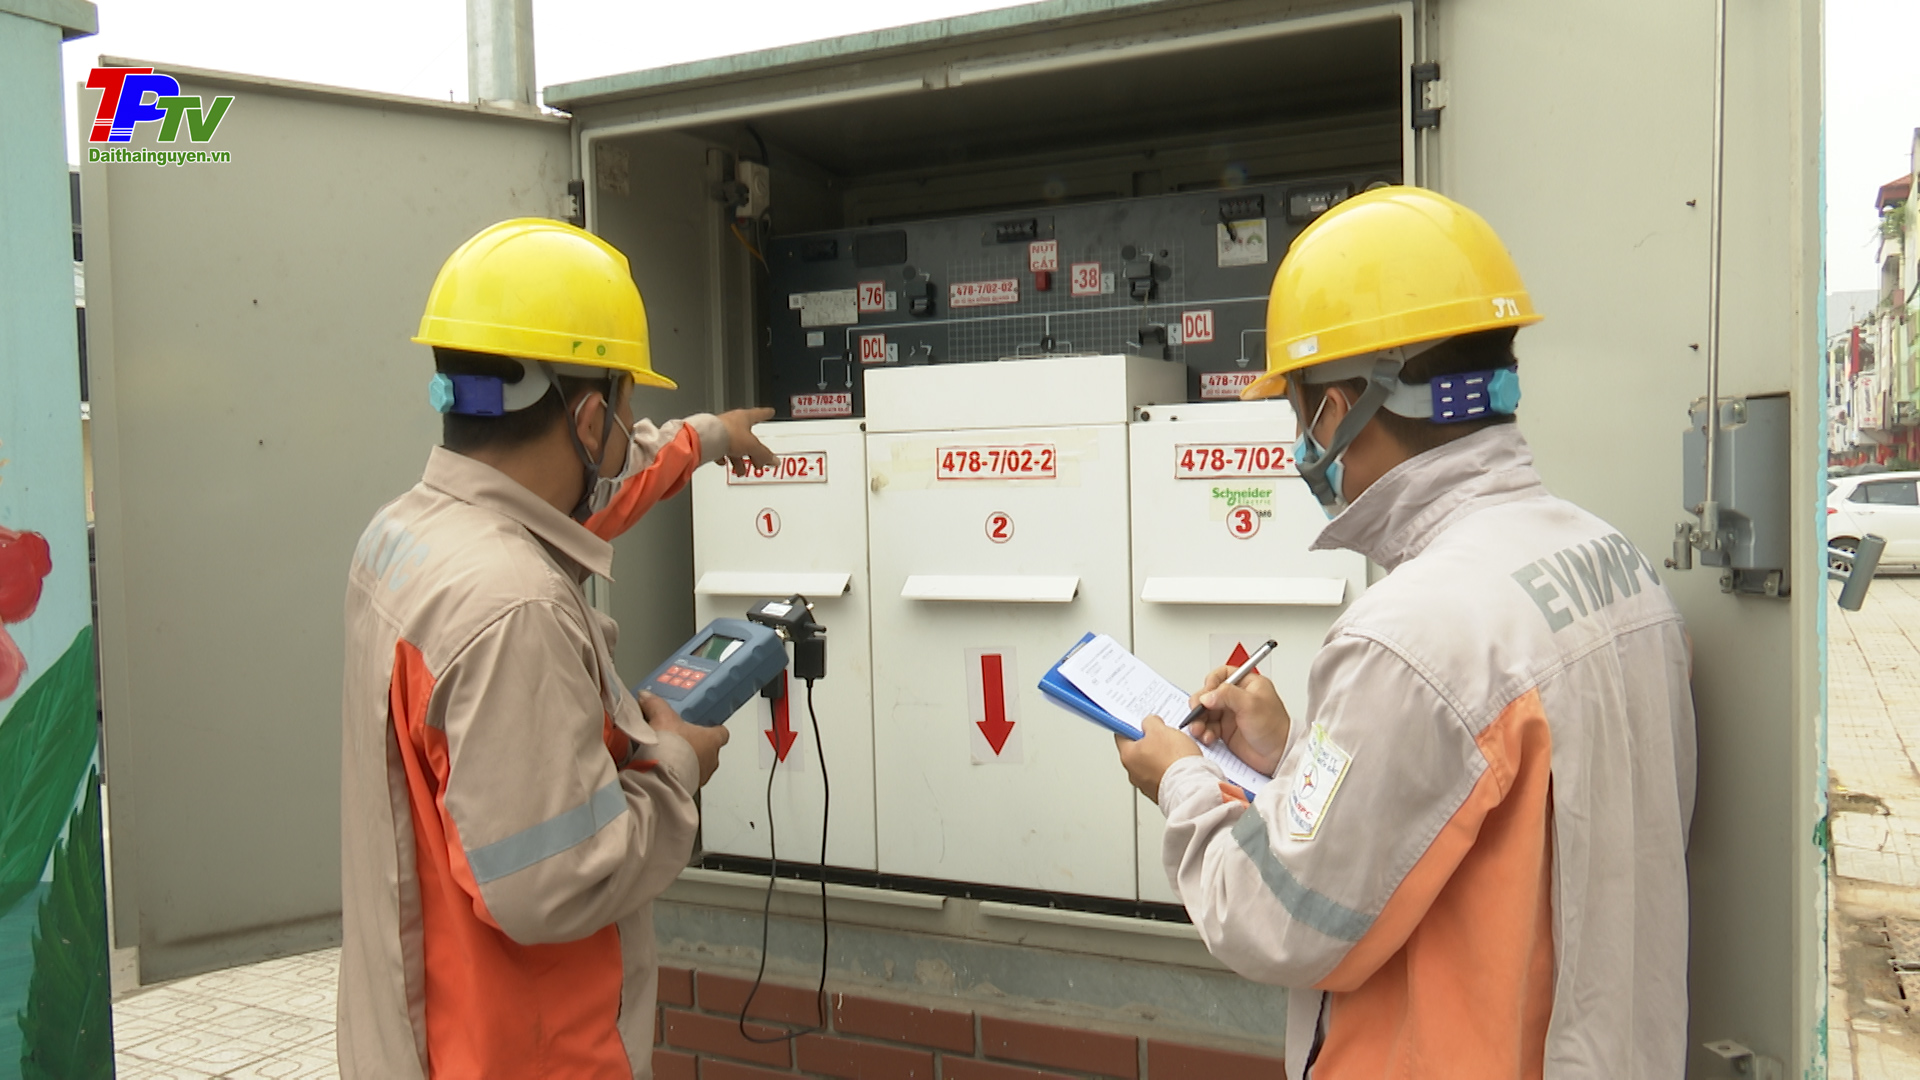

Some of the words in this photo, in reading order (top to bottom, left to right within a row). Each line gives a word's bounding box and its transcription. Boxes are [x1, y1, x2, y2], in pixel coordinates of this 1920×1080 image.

[957, 281, 1013, 296] 478-7/02-02
[1074, 267, 1098, 289] -38
[861, 287, 882, 306] -76
[1185, 314, 1210, 338] DCL
[863, 337, 884, 359] DCL
[942, 448, 1053, 475] 478-7/02-2
[1180, 446, 1298, 474] 478-7/02-
[1211, 487, 1273, 507] Schneider
[762, 512, 774, 534] 1
[992, 516, 1008, 539] 2
[1234, 508, 1253, 535] 3
